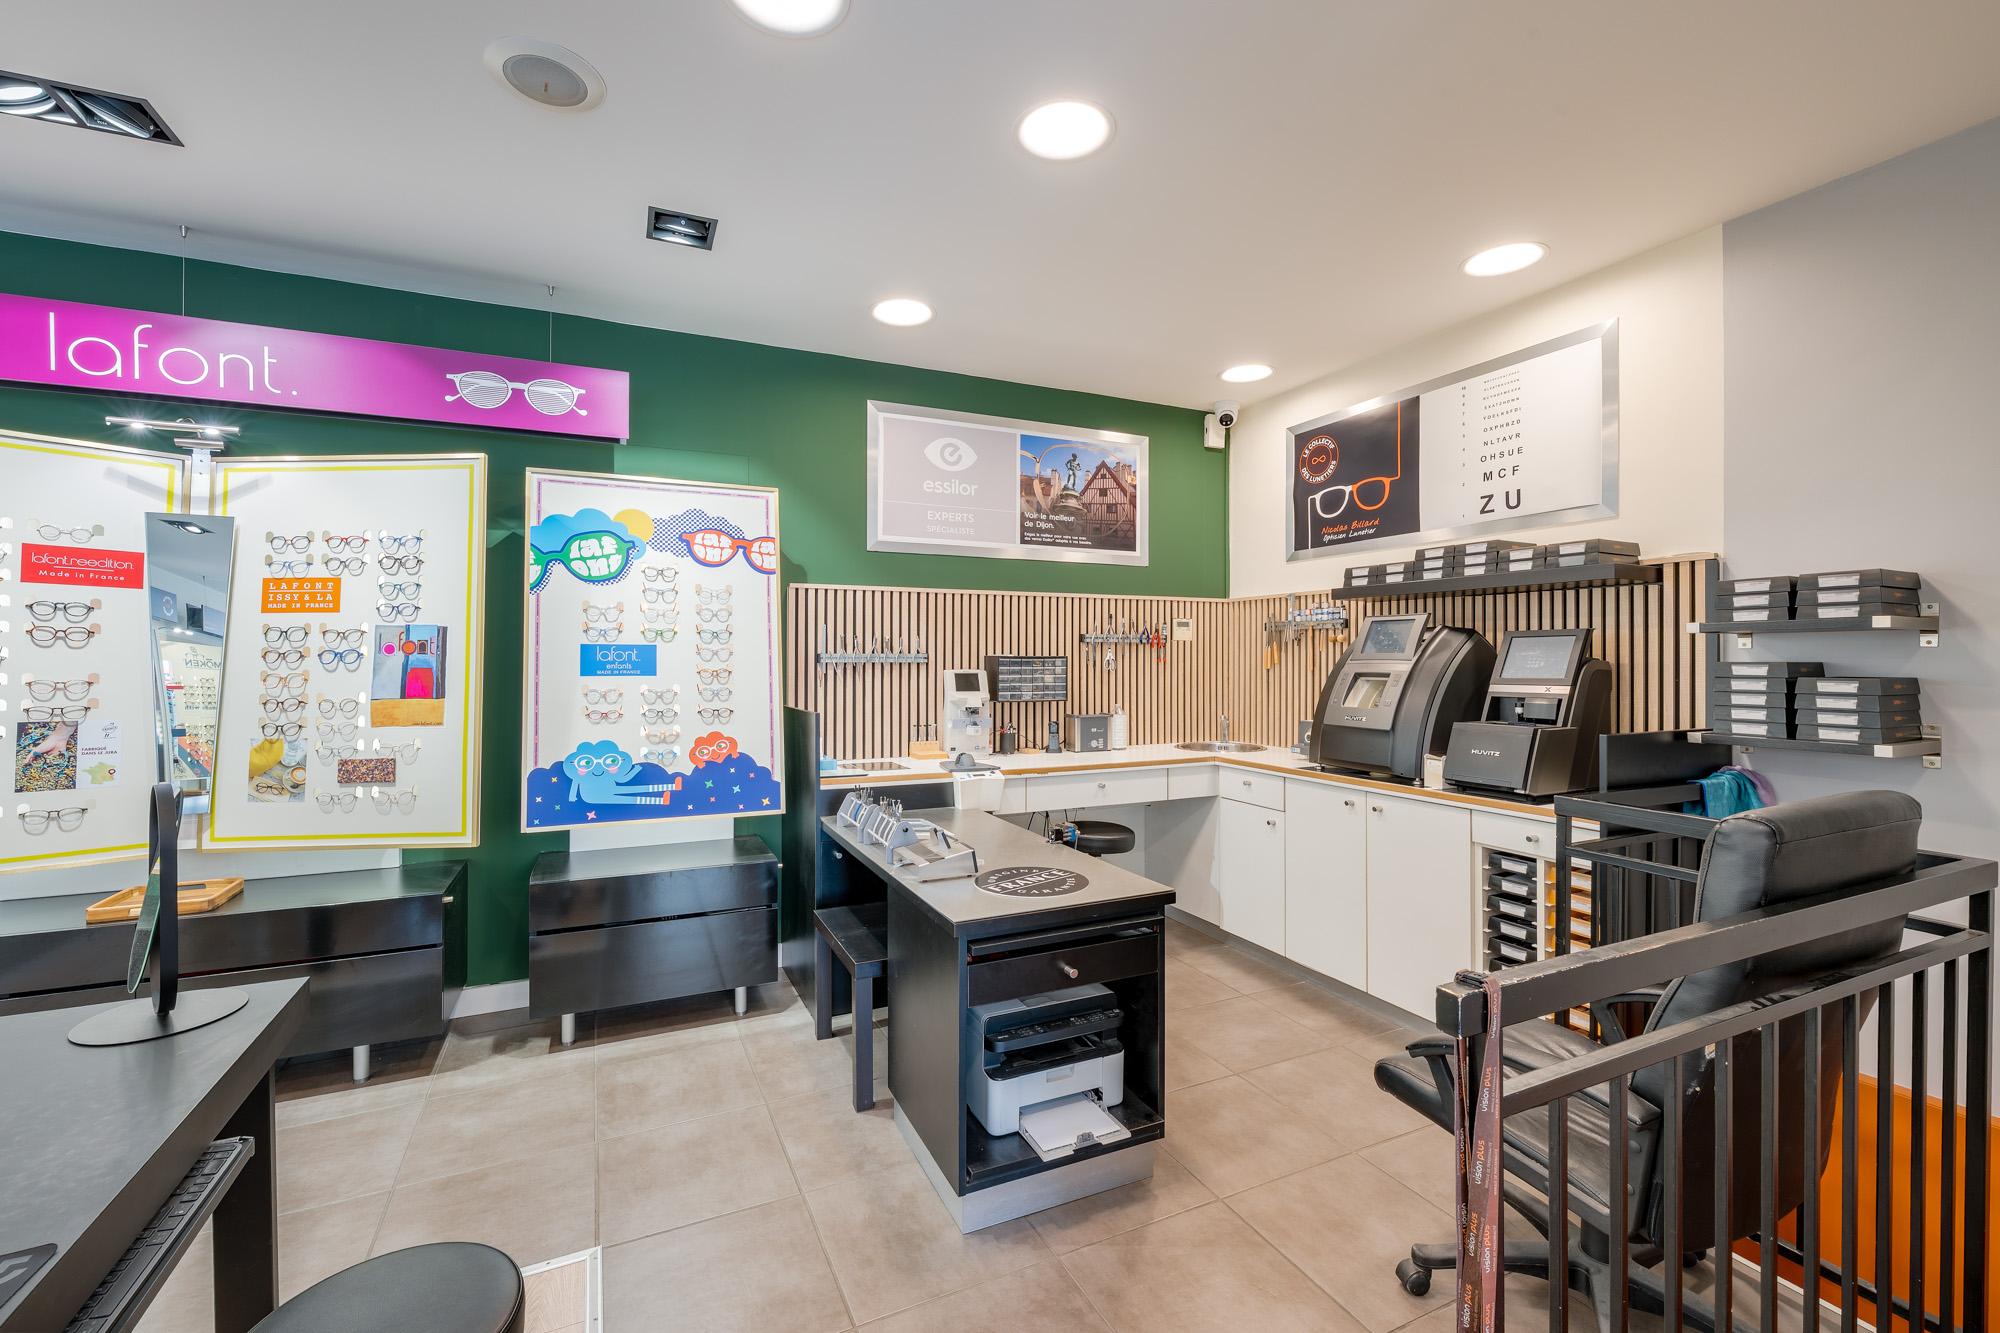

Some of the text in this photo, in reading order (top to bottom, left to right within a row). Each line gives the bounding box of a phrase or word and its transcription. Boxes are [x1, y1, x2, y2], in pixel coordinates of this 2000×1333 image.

[49, 312, 298, 396] lafont.
[1302, 438, 1335, 458] LE COLLECTIF
[1309, 460, 1336, 482] LUNETIERS
[923, 480, 978, 496] essilor
[928, 510, 975, 522] EXPERTS
[1036, 521, 1054, 529] Dijon.
[1049, 514, 1075, 522] meilleur
[1322, 518, 1380, 534] Nicolas Billard
[596, 646, 640, 662] lafont.
[986, 870, 1070, 892] FRANCE
[1480, 1067, 1491, 1112] vision plus
[1473, 1140, 1485, 1184] vision plus
[1467, 1212, 1478, 1256] vision plus
[1483, 1225, 1491, 1246] plus
[1461, 1284, 1473, 1328] vision plus
